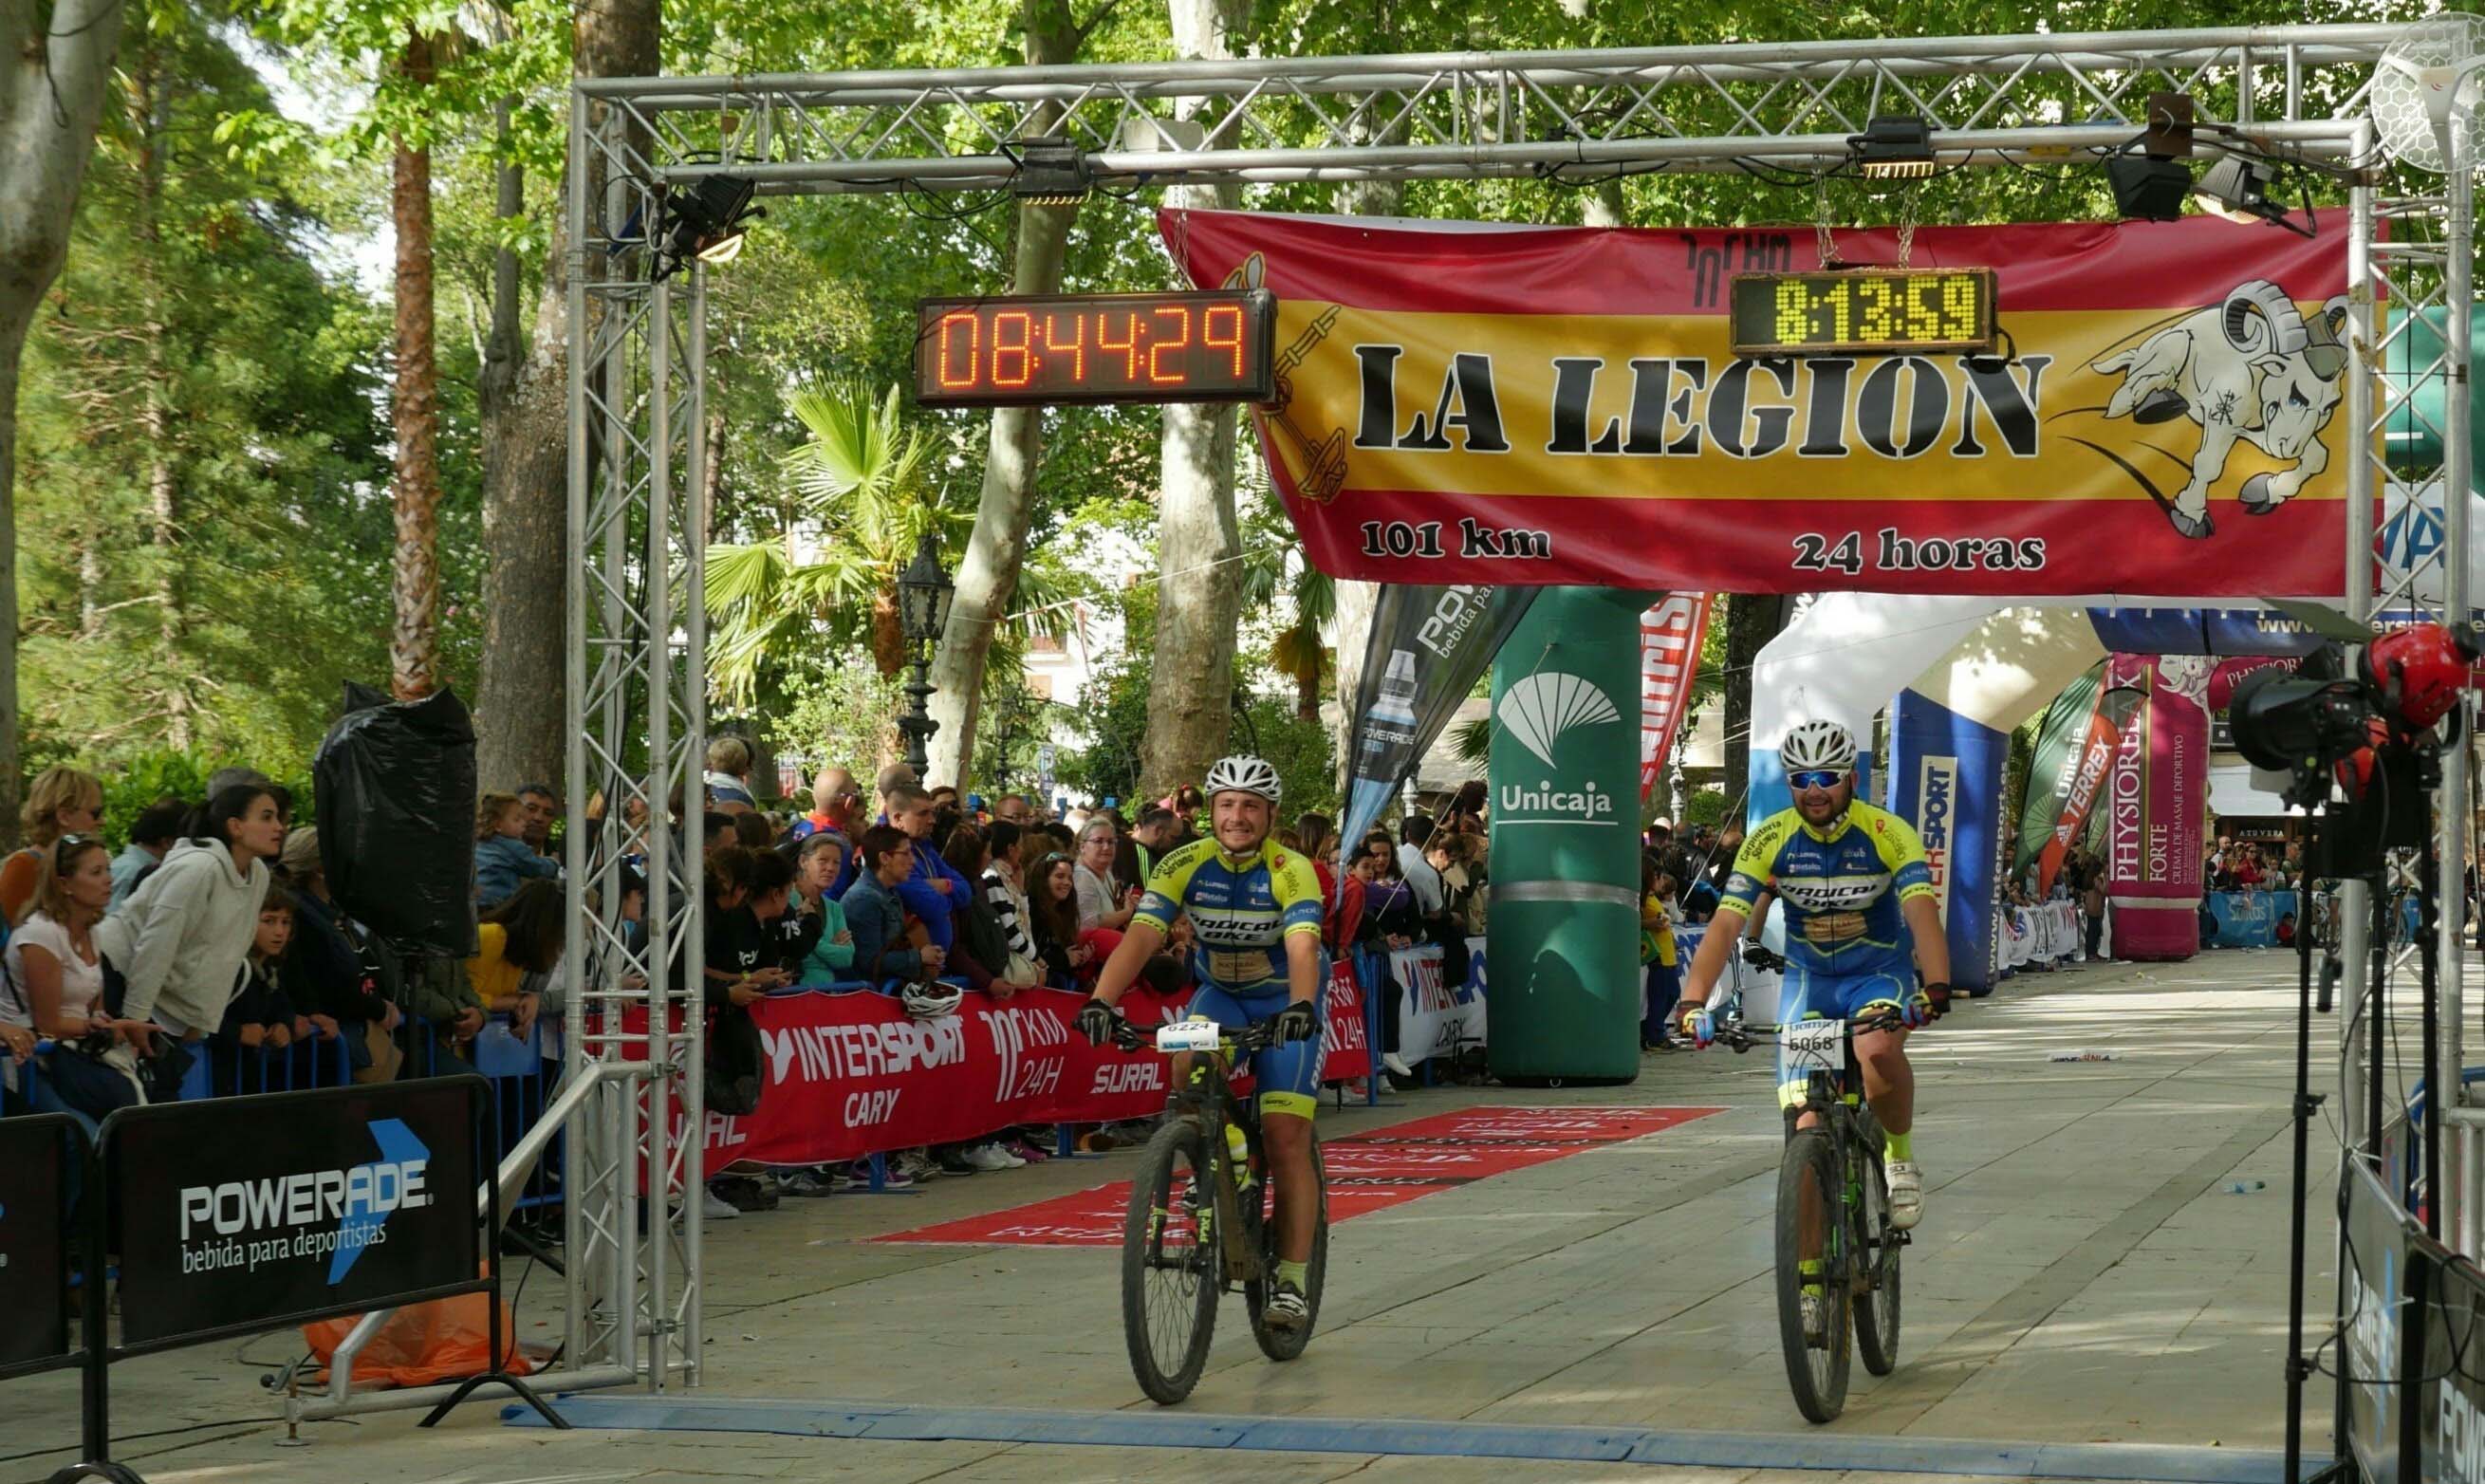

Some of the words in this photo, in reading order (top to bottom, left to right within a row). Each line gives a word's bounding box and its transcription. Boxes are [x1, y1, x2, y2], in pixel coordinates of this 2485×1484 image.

[1774, 275, 1976, 346] 8:13:59
[939, 306, 1243, 389] 08:44:29
[1352, 343, 1511, 453] LA
[1546, 353, 2054, 459] LEGION
[1361, 520, 1445, 560] 101
[1459, 516, 1551, 562] km
[1791, 531, 1862, 576] 24
[1876, 527, 2046, 572] horas
[1437, 608, 1477, 659] bebida
[2055, 728, 2086, 799] Unicaja
[2064, 734, 2112, 818] TERREX
[2173, 734, 2184, 792] DEPORTIVO
[1501, 780, 1613, 820] Unicaja
[2172, 794, 2184, 831] MASAJE
[2149, 824, 2168, 882] FORTE
[2172, 830, 2183, 845] DE
[2172, 847, 2183, 884] CREMA
[1203, 932, 1263, 942] BIKE
[793, 1014, 966, 1083] INTERSPORT
[1021, 1008, 1068, 1047] KM
[1336, 1016, 1367, 1051] 24H
[1790, 1036, 1833, 1051] 6068
[1015, 1056, 1064, 1100] 24H
[1092, 1062, 1164, 1094] SURAL
[844, 1087, 901, 1128] CARY
[180, 1159, 426, 1240] POWERADE
[181, 1240, 244, 1274] bebida
[249, 1238, 289, 1272] para
[294, 1221, 387, 1267] deportistas
